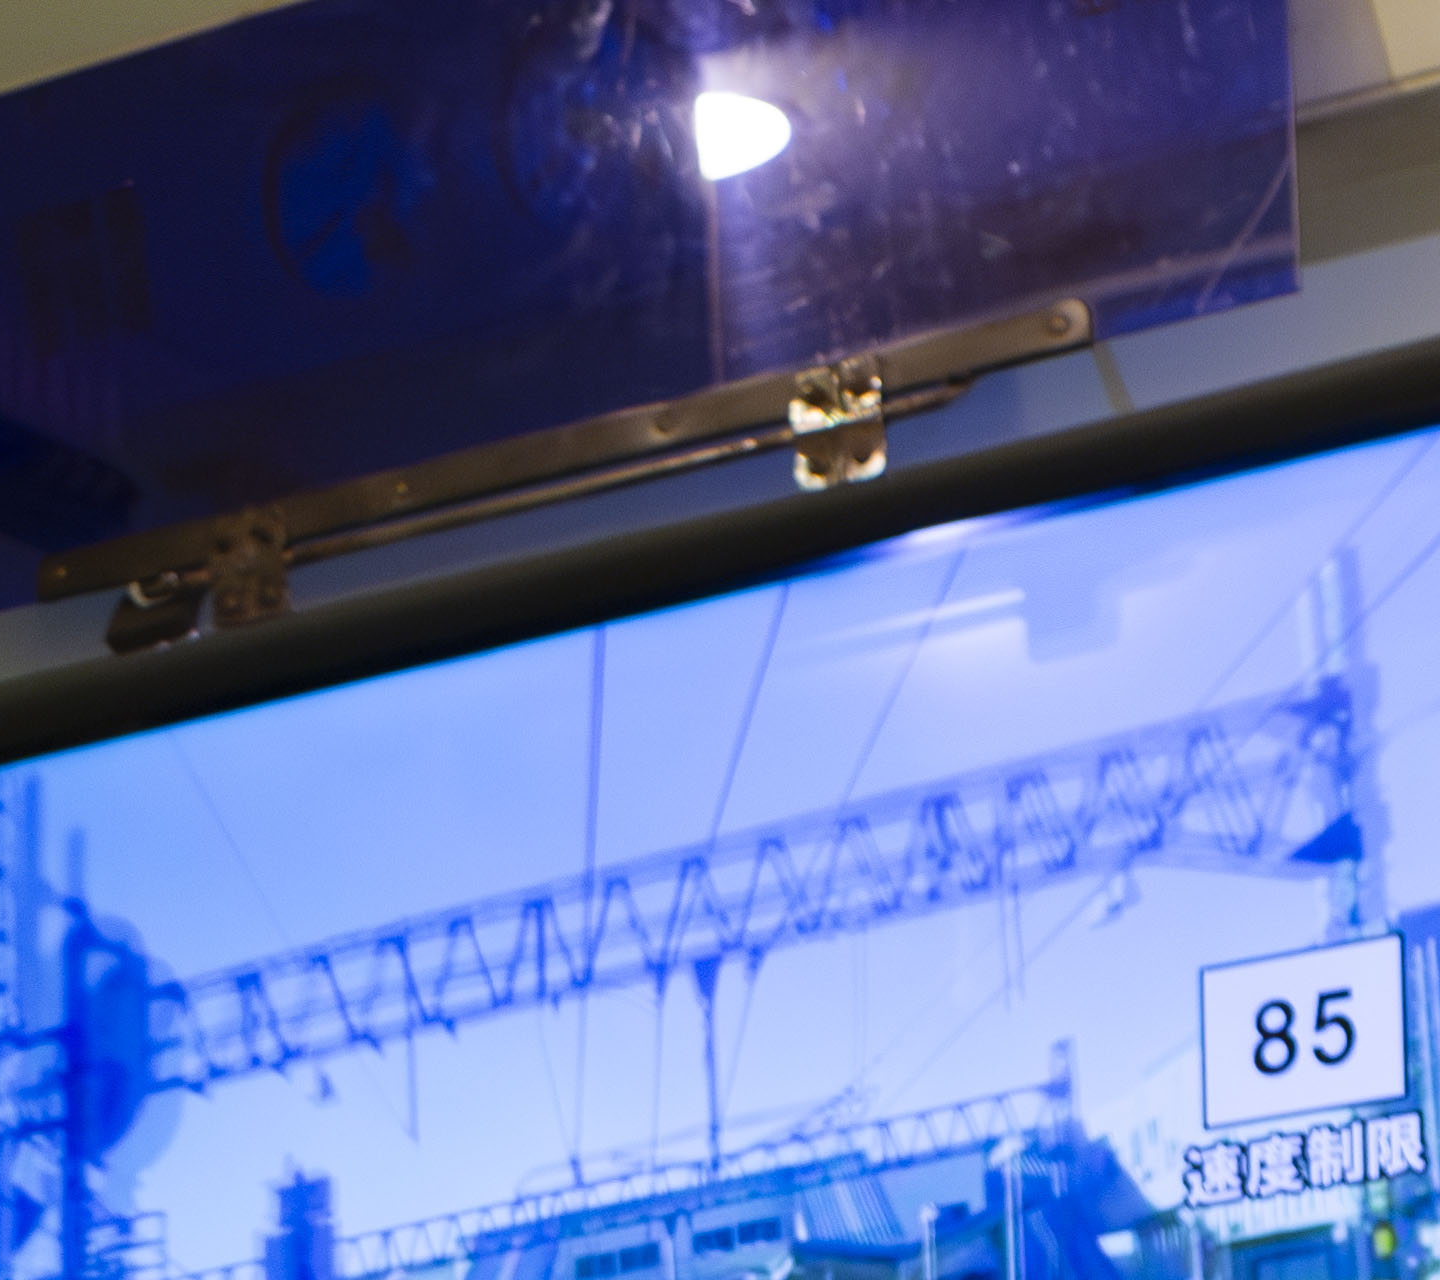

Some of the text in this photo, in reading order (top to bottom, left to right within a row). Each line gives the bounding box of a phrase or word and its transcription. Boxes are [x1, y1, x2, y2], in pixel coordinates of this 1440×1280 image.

[1254, 988, 1357, 1076] 85
[1183, 1111, 1427, 1207] 速度制限
